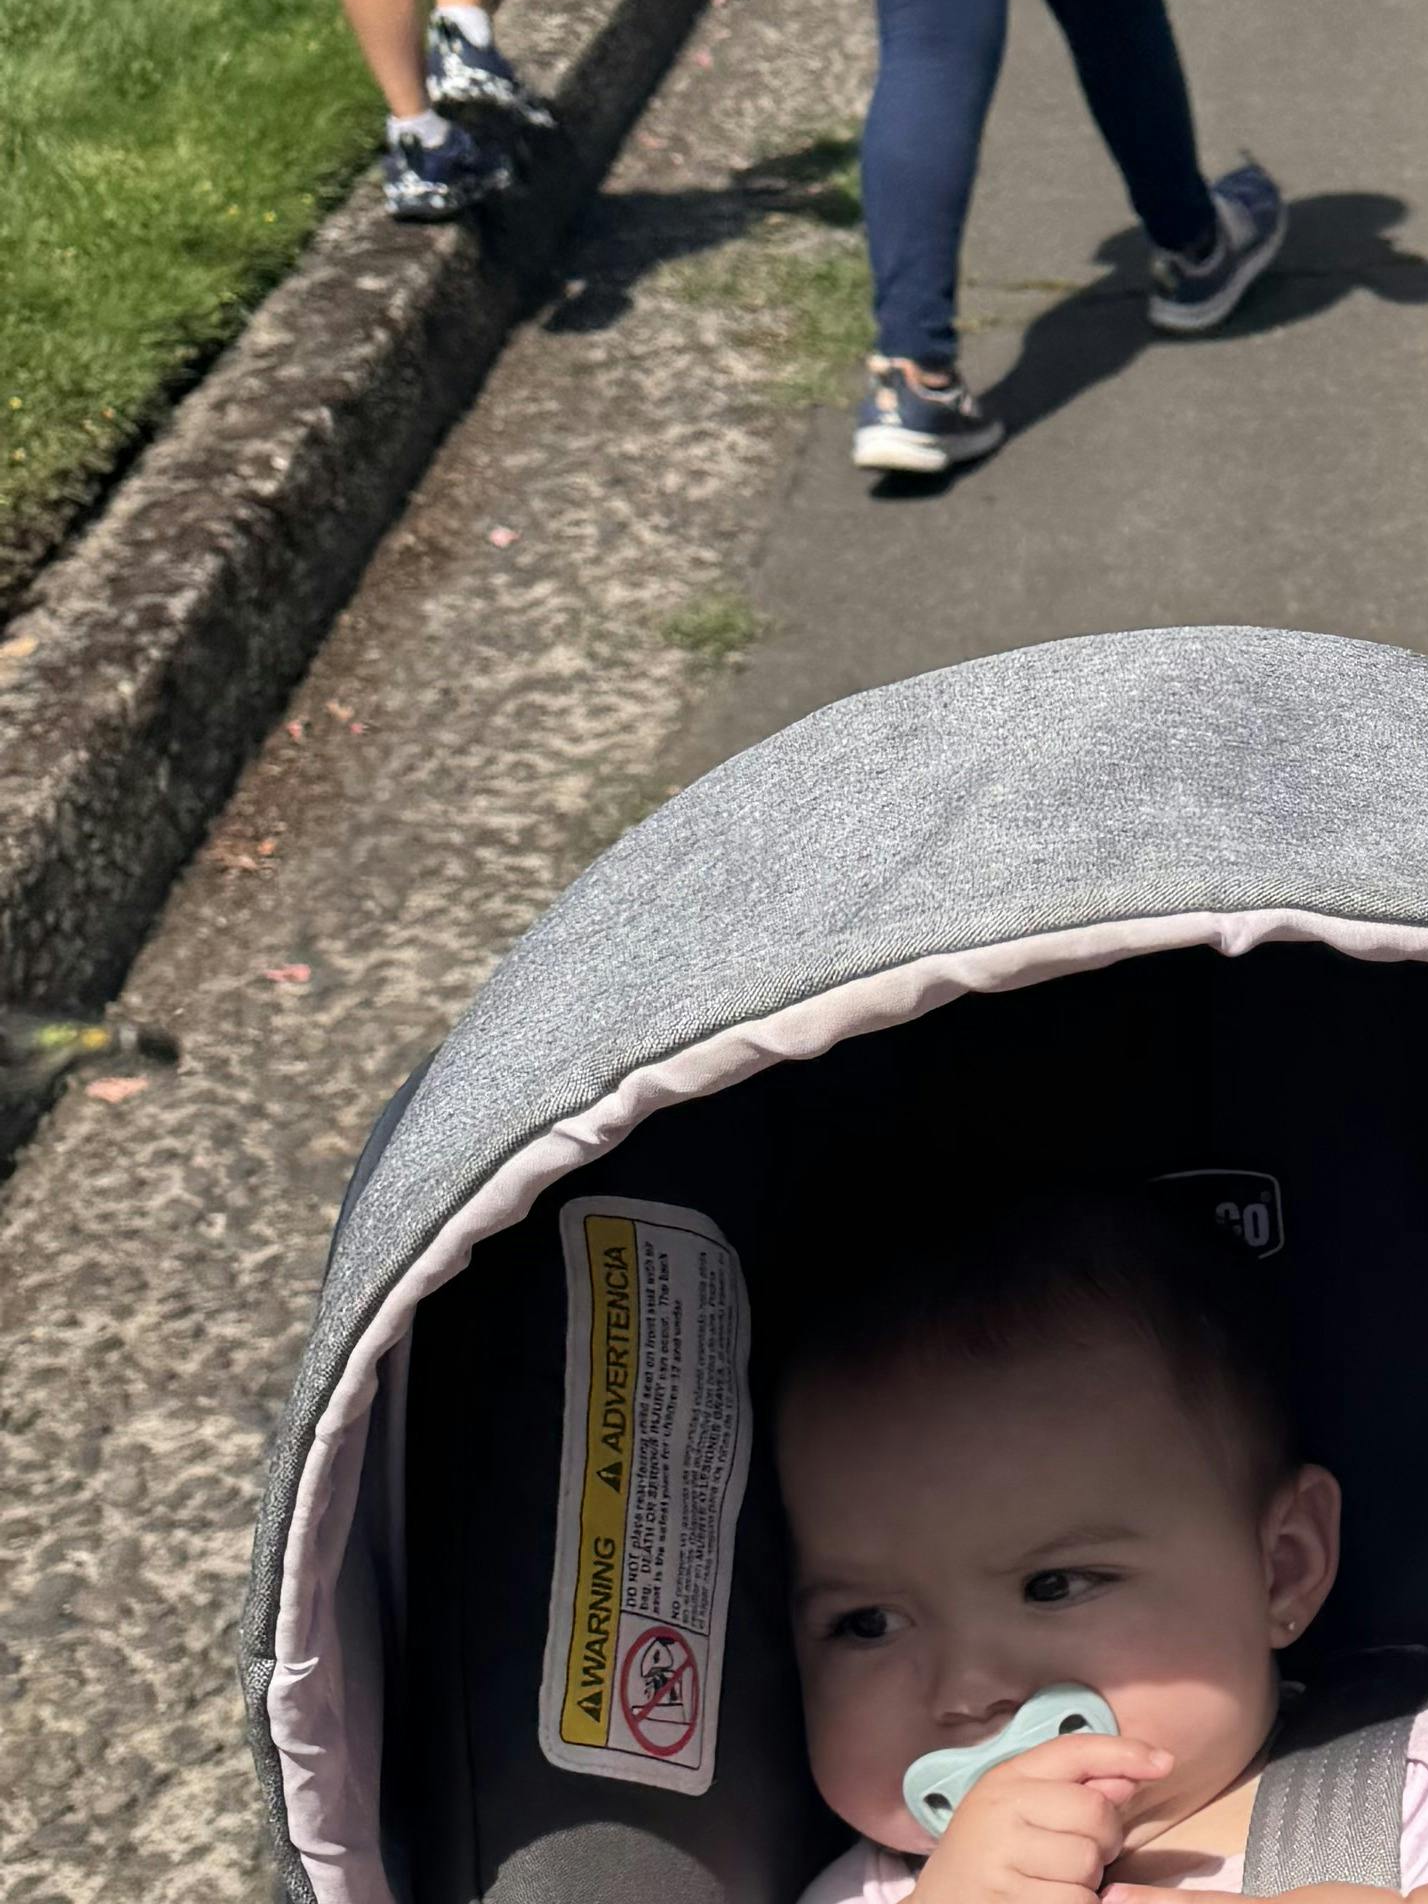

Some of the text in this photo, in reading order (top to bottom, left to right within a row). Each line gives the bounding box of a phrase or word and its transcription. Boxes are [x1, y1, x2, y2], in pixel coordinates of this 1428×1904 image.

[581, 1247, 630, 1688] WARNING ADVERTENCIA
[628, 1553, 640, 1582] NOT
[641, 1527, 654, 1573] DEATH
[626, 1586, 637, 1608] DO
